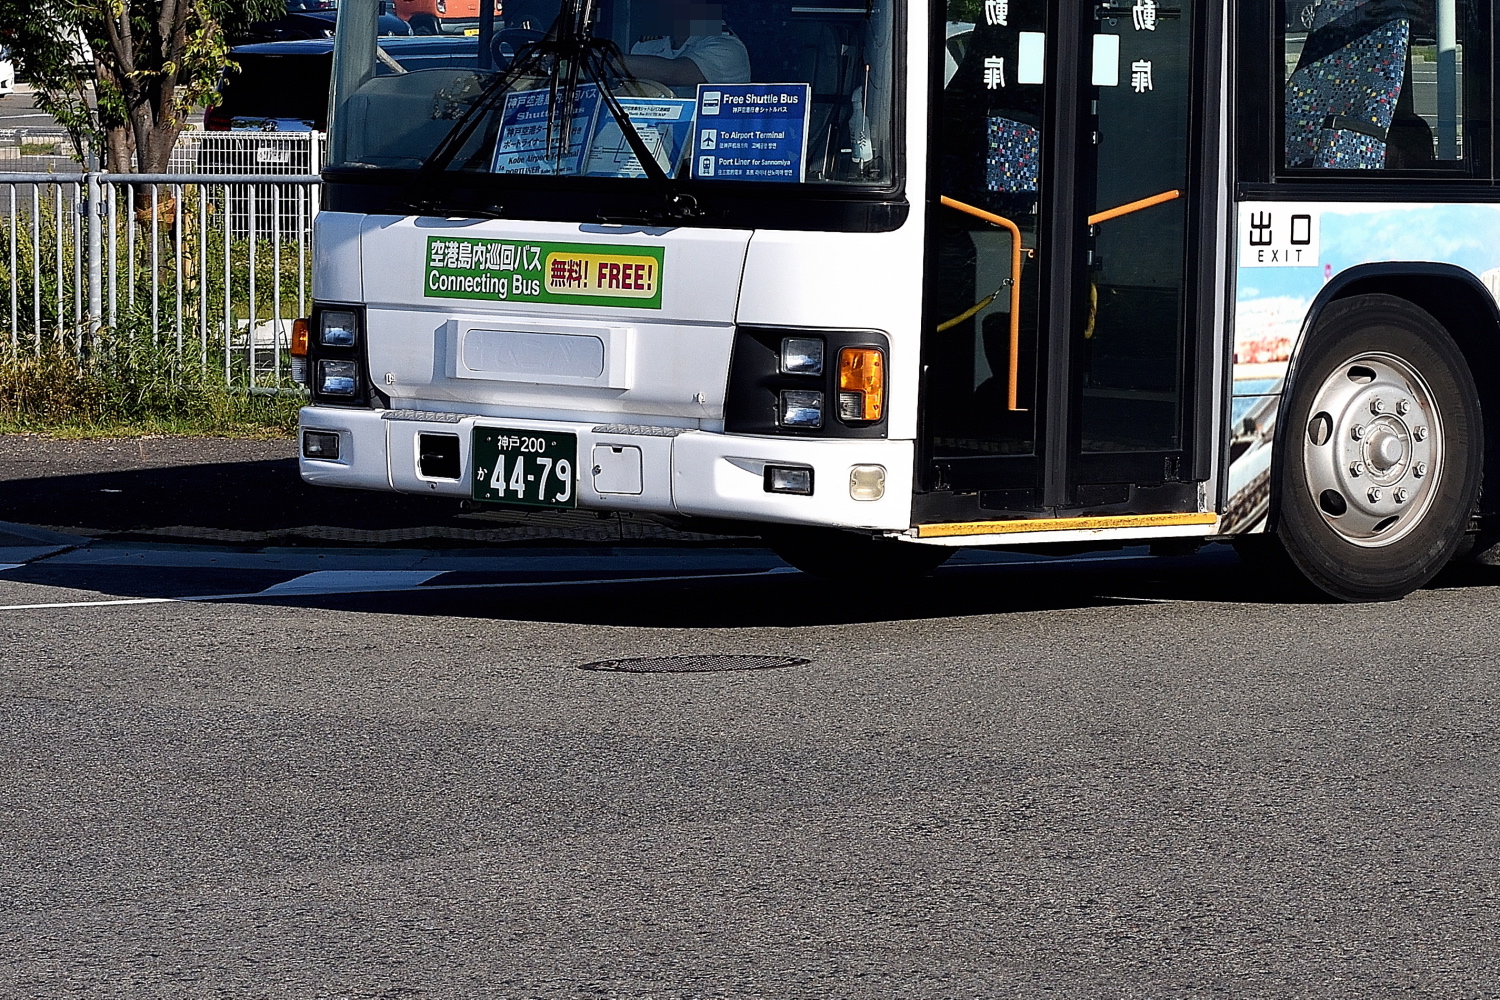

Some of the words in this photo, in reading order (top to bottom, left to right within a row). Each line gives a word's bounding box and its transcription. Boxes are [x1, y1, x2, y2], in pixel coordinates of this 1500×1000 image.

[723, 94, 744, 104] Free
[745, 93, 778, 104] Shuttle
[780, 93, 799, 104] Bus
[517, 110, 559, 121] Shutte
[720, 131, 729, 139] To
[731, 131, 754, 140] Airport
[755, 131, 785, 139] Terminal
[718, 158, 733, 166] Port
[734, 158, 751, 166] Liner
[752, 158, 761, 166] for
[761, 158, 791, 167] Sannomiya
[1250, 211, 1311, 246] 出口
[430, 240, 542, 272] 空港島内巡回バス
[1258, 249, 1302, 262] EXIT
[429, 270, 508, 298] Connecting
[512, 274, 540, 296] Bus
[597, 262, 653, 291] FREE!
[477, 467, 488, 481] か
[490, 454, 572, 502] 44-79
